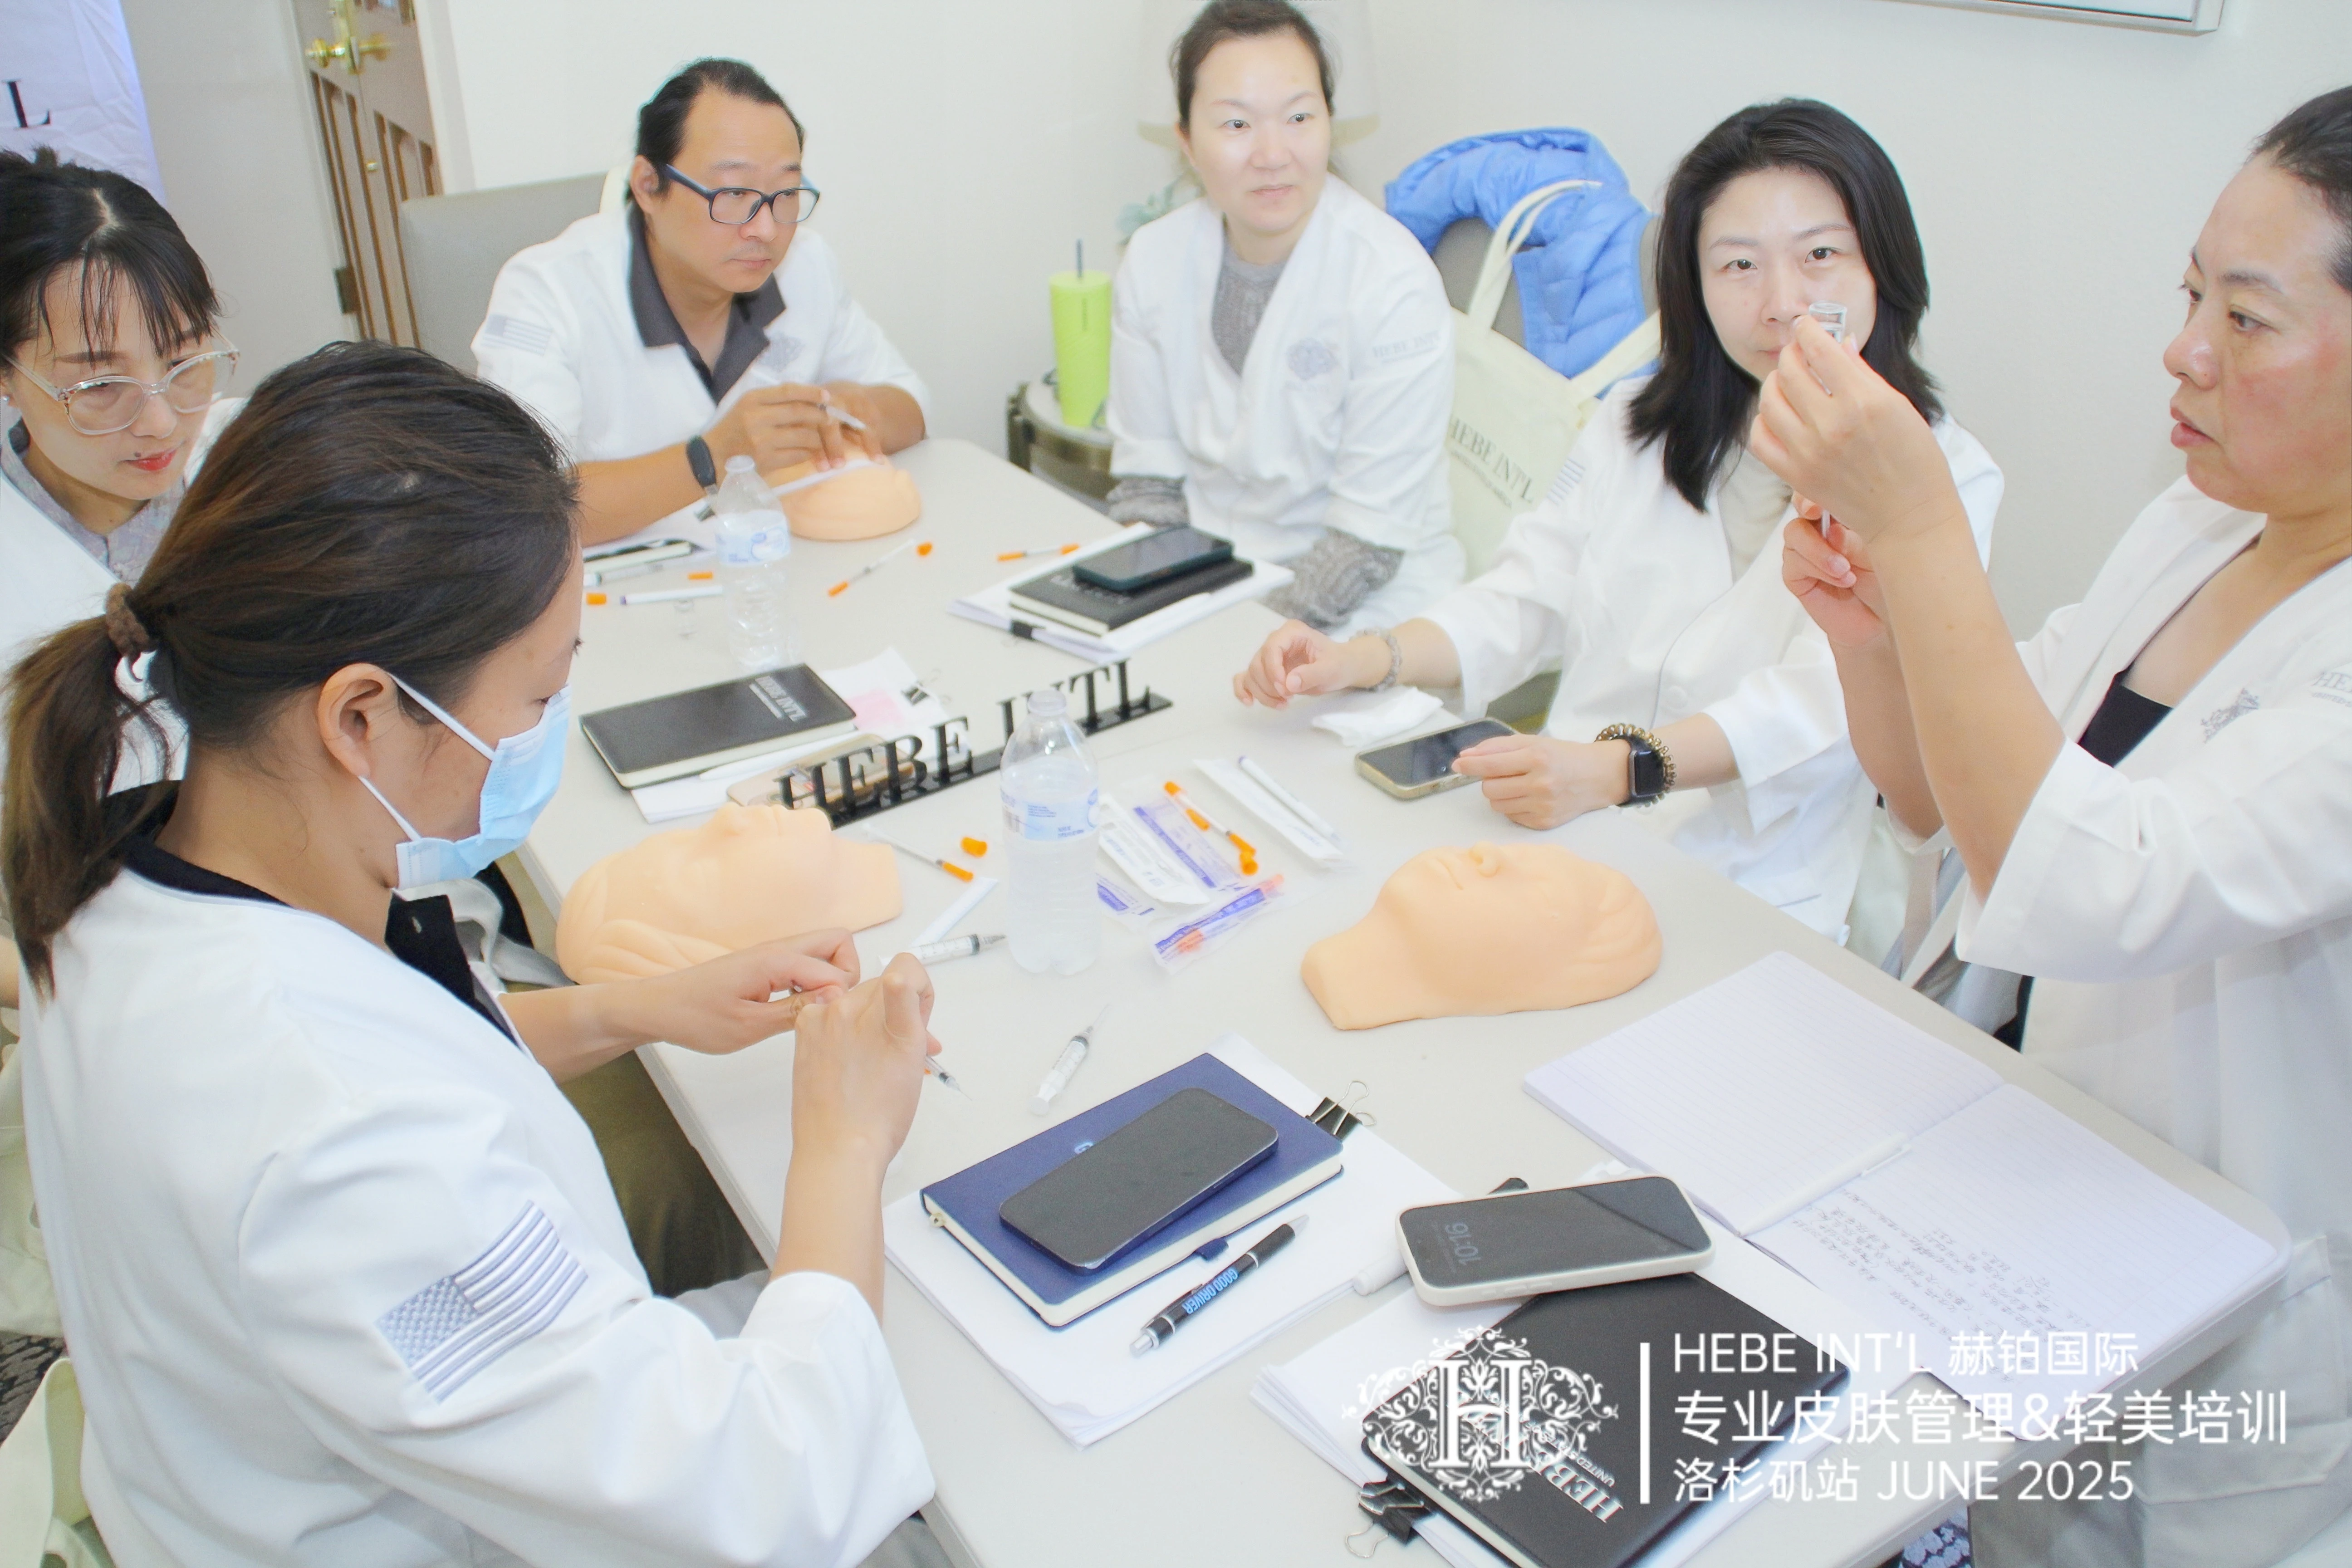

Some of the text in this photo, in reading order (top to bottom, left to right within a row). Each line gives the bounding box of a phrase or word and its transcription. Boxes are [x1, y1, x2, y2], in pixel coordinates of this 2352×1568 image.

[773, 715, 975, 815] HEBE
[1445, 1223, 1482, 1265] 10:16
[1181, 1268, 1239, 1315] GOOD DRIVER
[1576, 1457, 1616, 1488] UNITED
